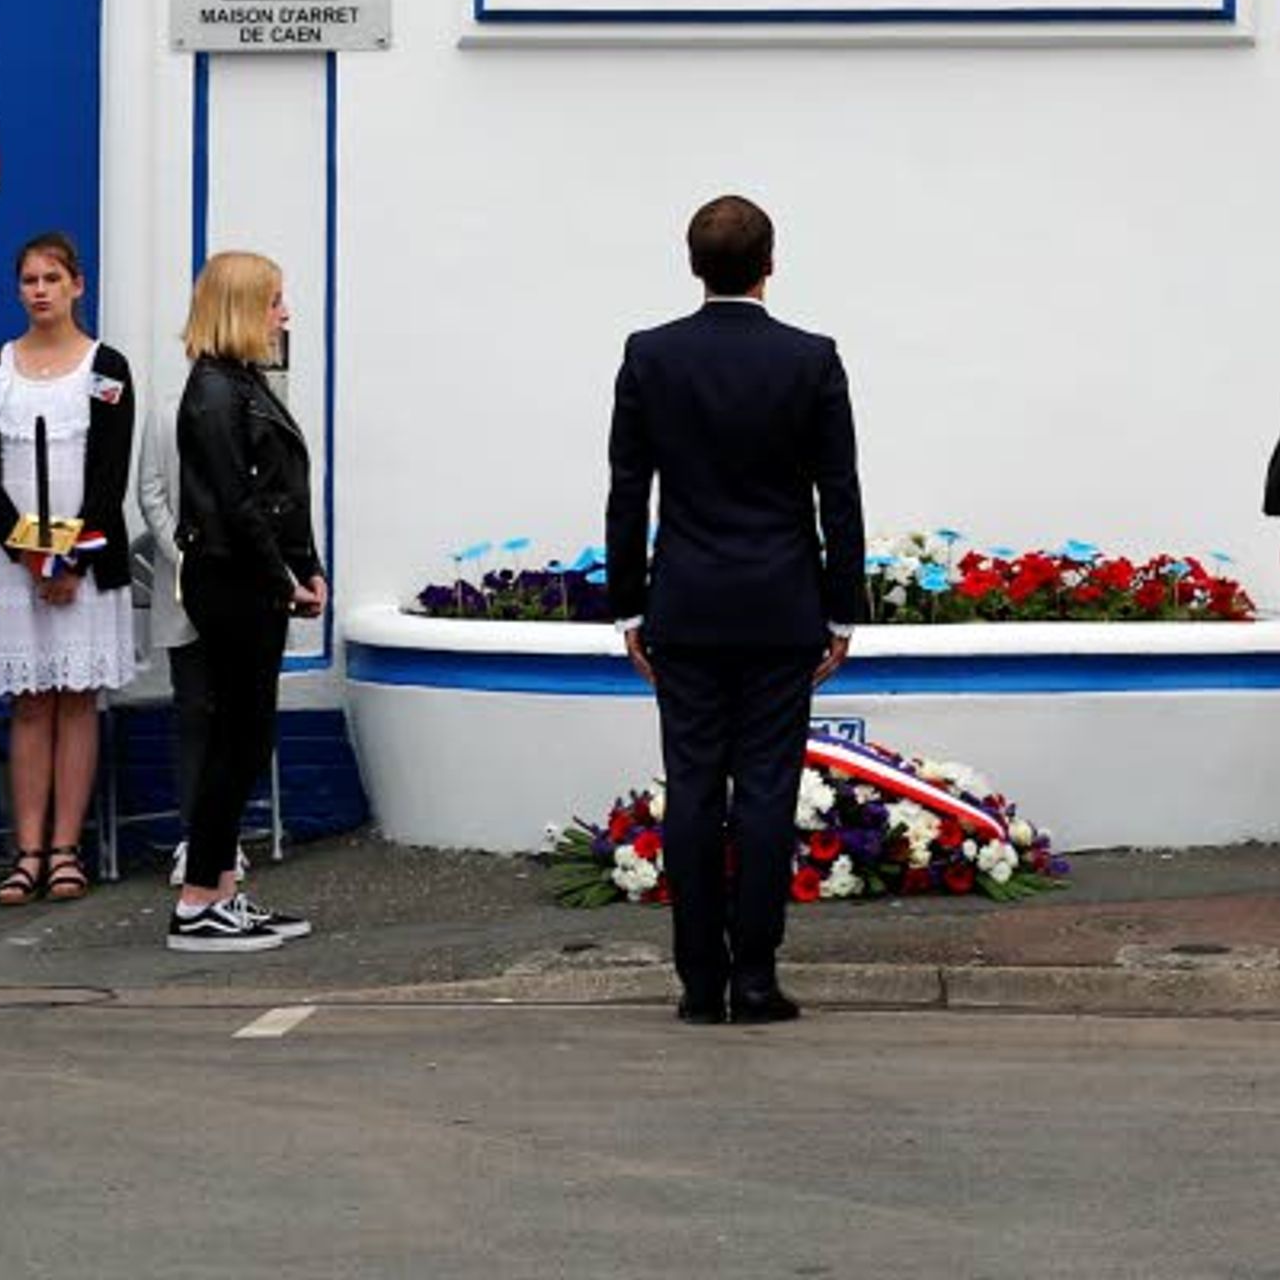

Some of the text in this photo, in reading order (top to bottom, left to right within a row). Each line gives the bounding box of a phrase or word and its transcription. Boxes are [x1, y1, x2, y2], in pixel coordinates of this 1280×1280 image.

[200, 6, 360, 24] MAISON D'ARRET
[239, 26, 322, 43] DE CAEN
